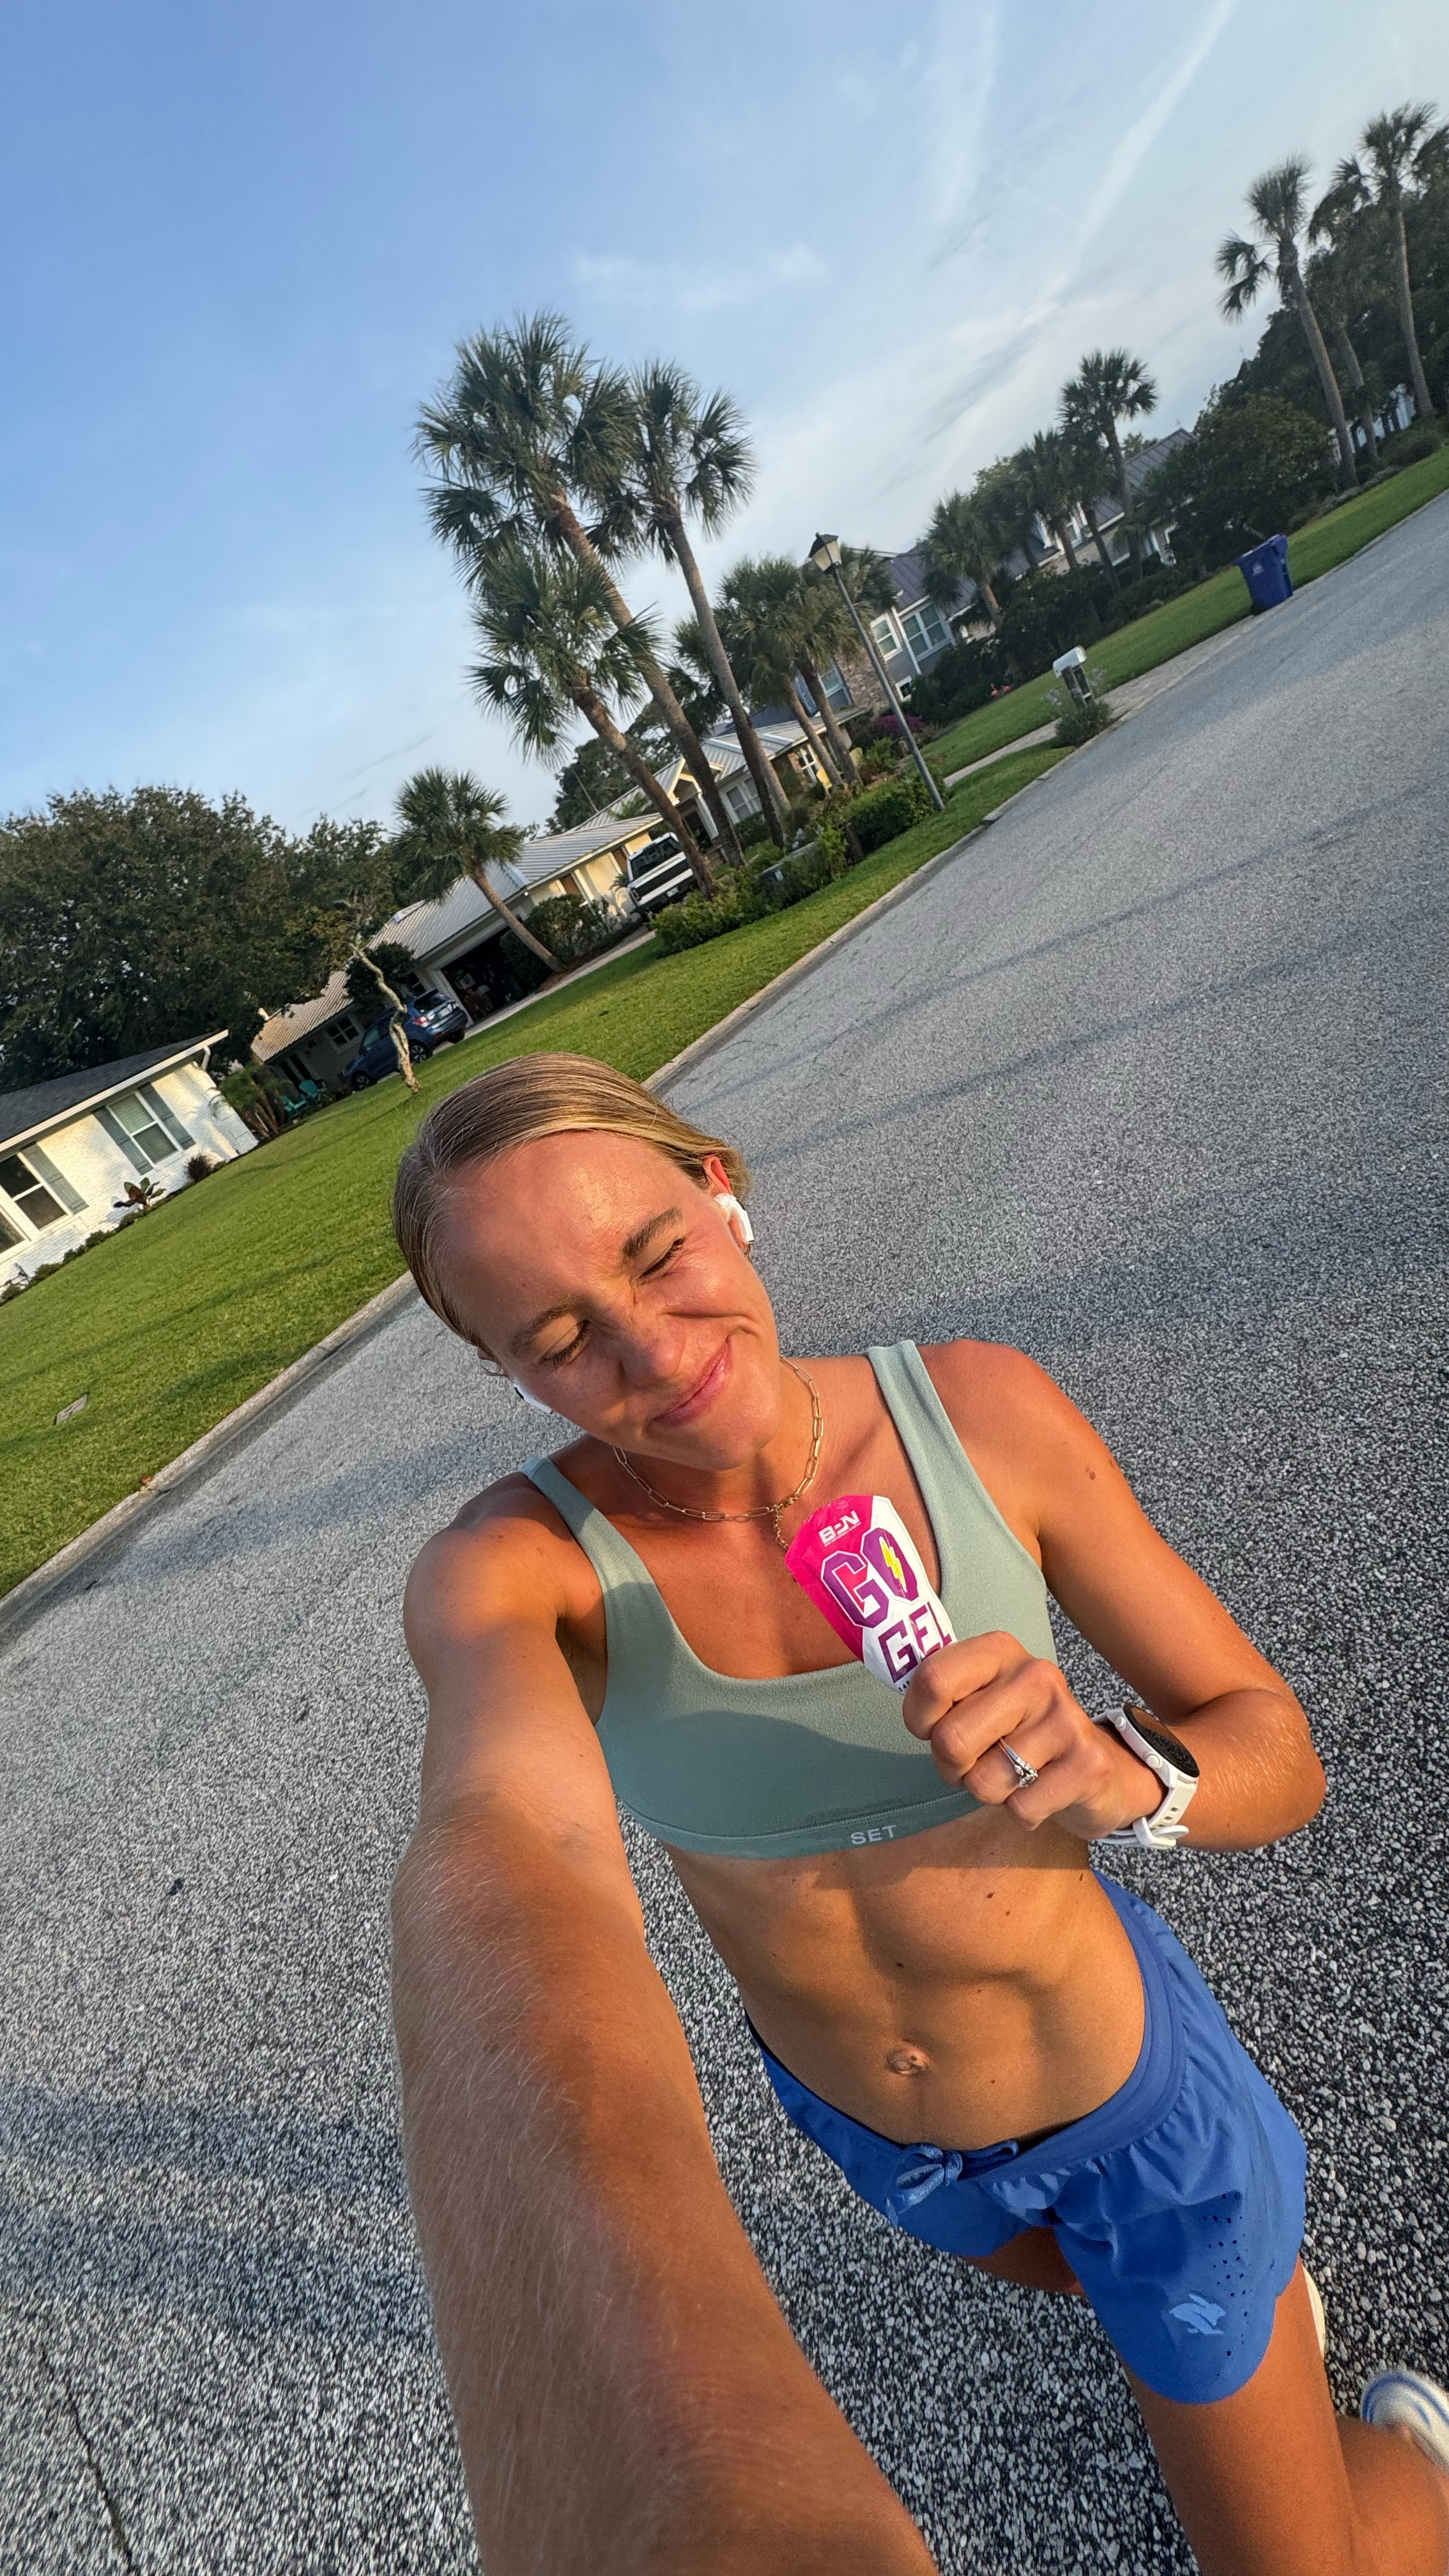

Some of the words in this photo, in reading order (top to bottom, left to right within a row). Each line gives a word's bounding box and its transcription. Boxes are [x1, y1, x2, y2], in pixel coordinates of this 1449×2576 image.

[821, 1526, 919, 1629] GO
[878, 1602, 953, 1684] GEL
[850, 1825, 897, 1844] SET
